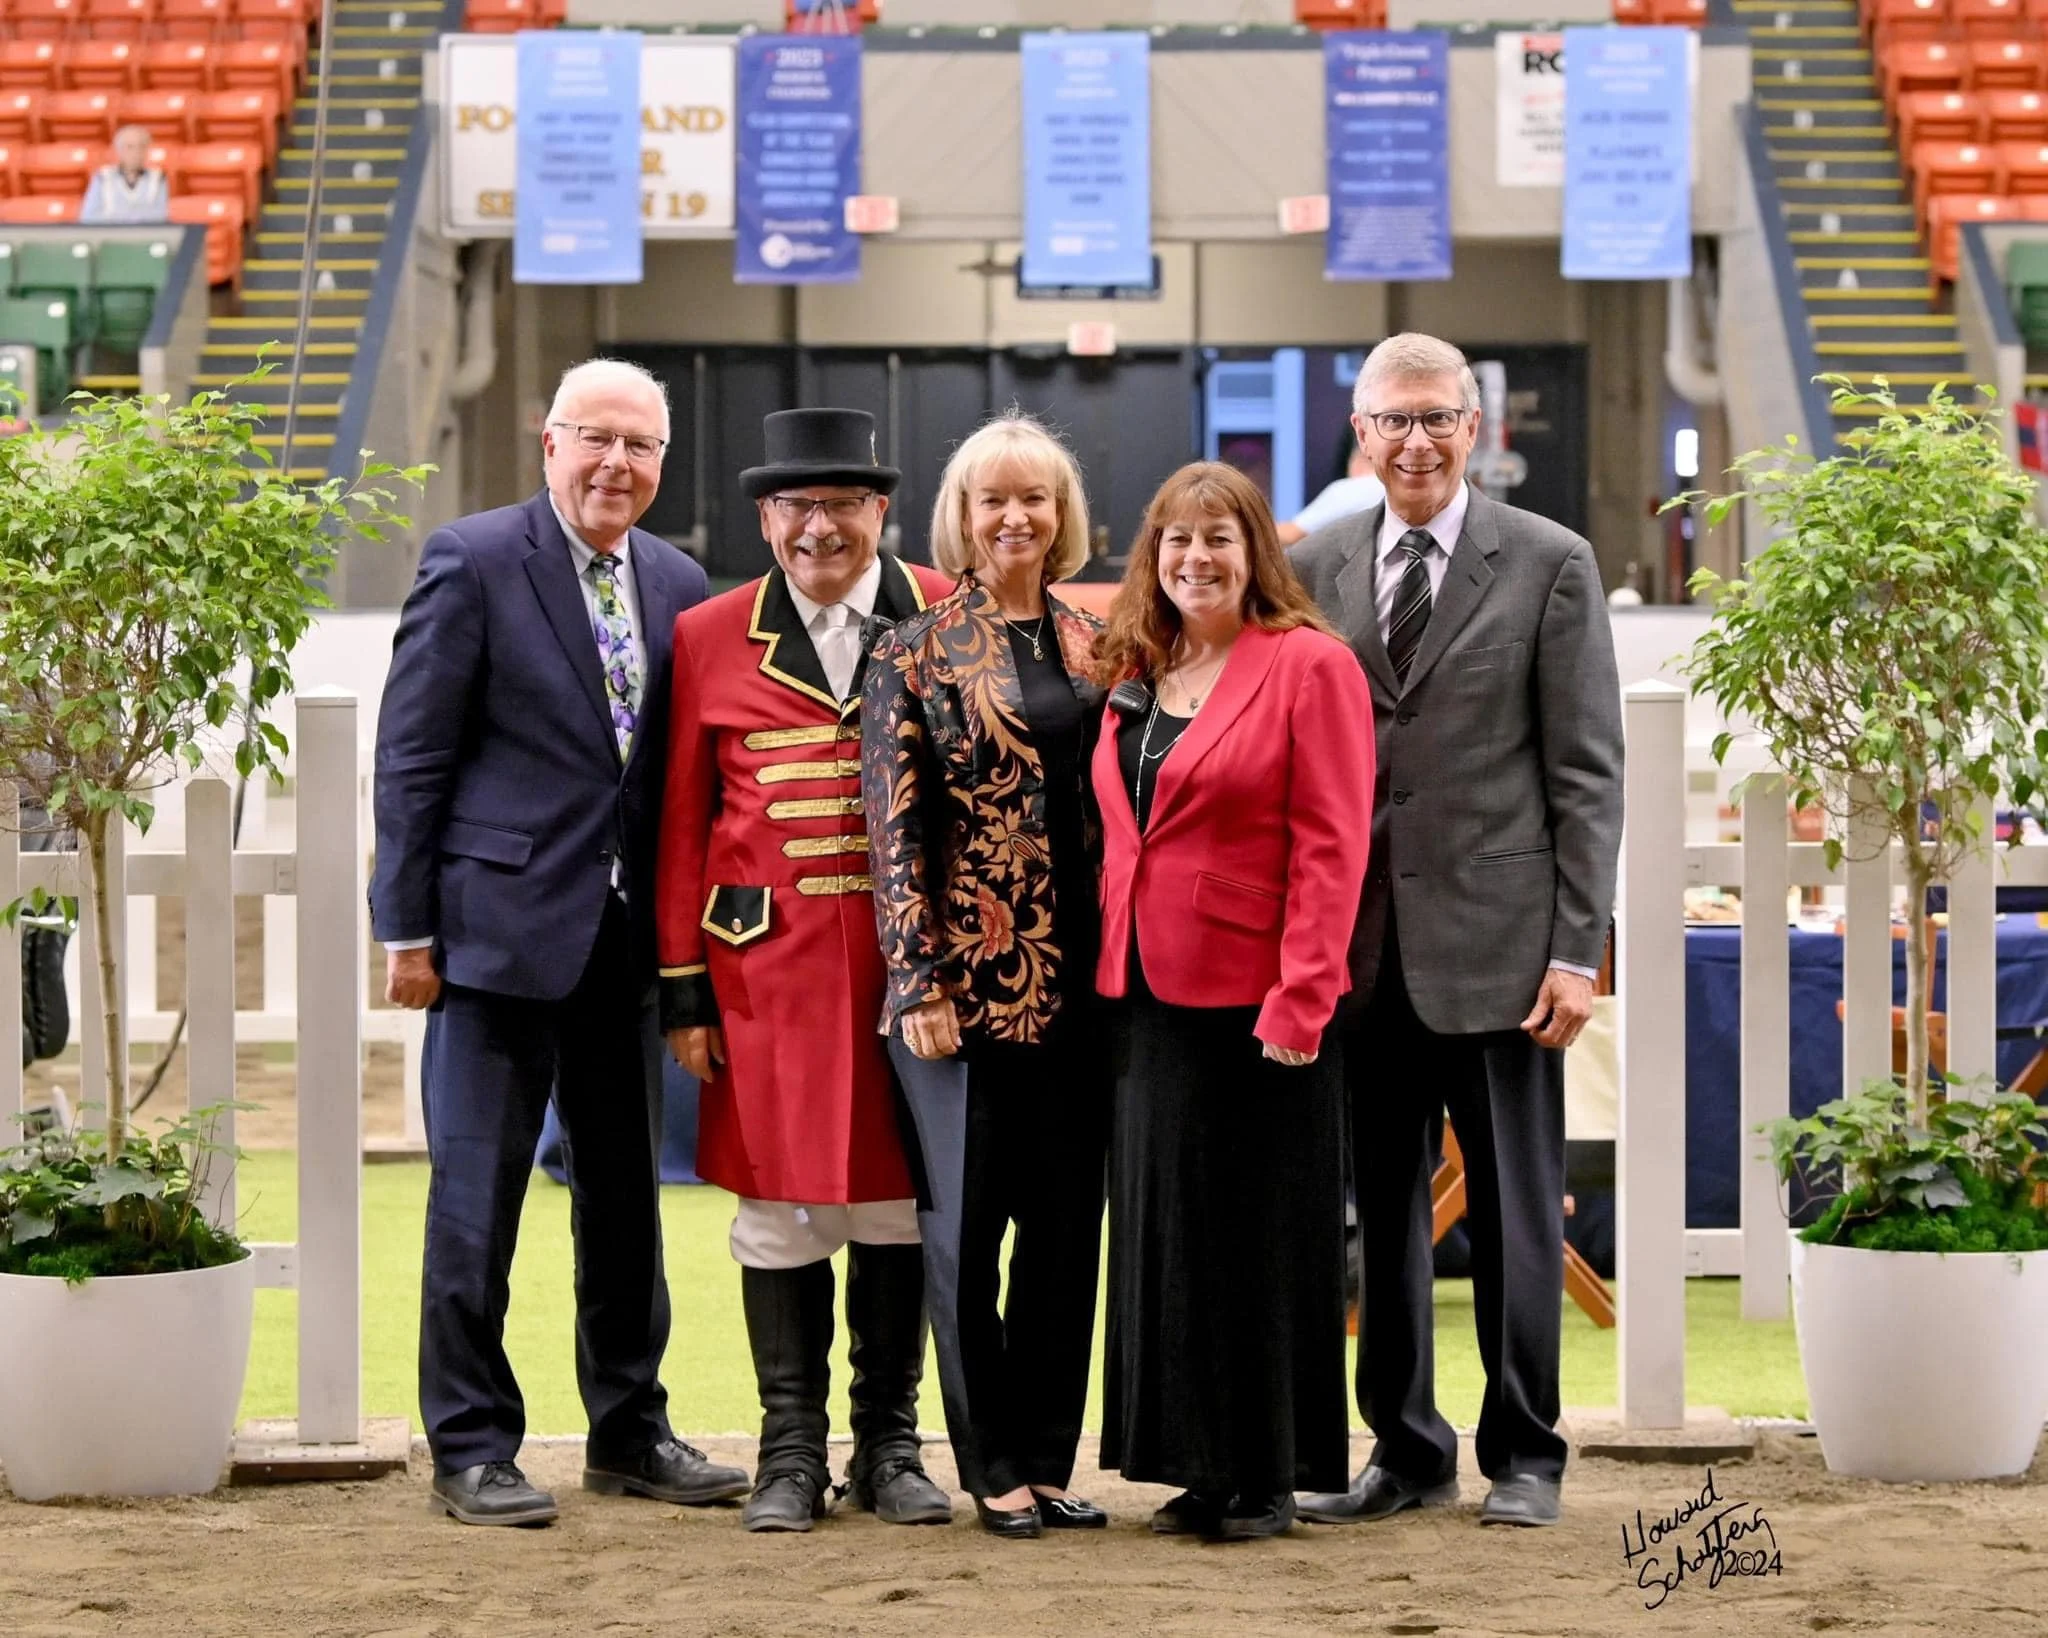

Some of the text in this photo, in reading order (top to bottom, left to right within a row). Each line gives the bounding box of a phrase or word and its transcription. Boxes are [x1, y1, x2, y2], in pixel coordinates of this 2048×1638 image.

[456, 104, 724, 132] FO AND
[666, 191, 707, 217] 19
